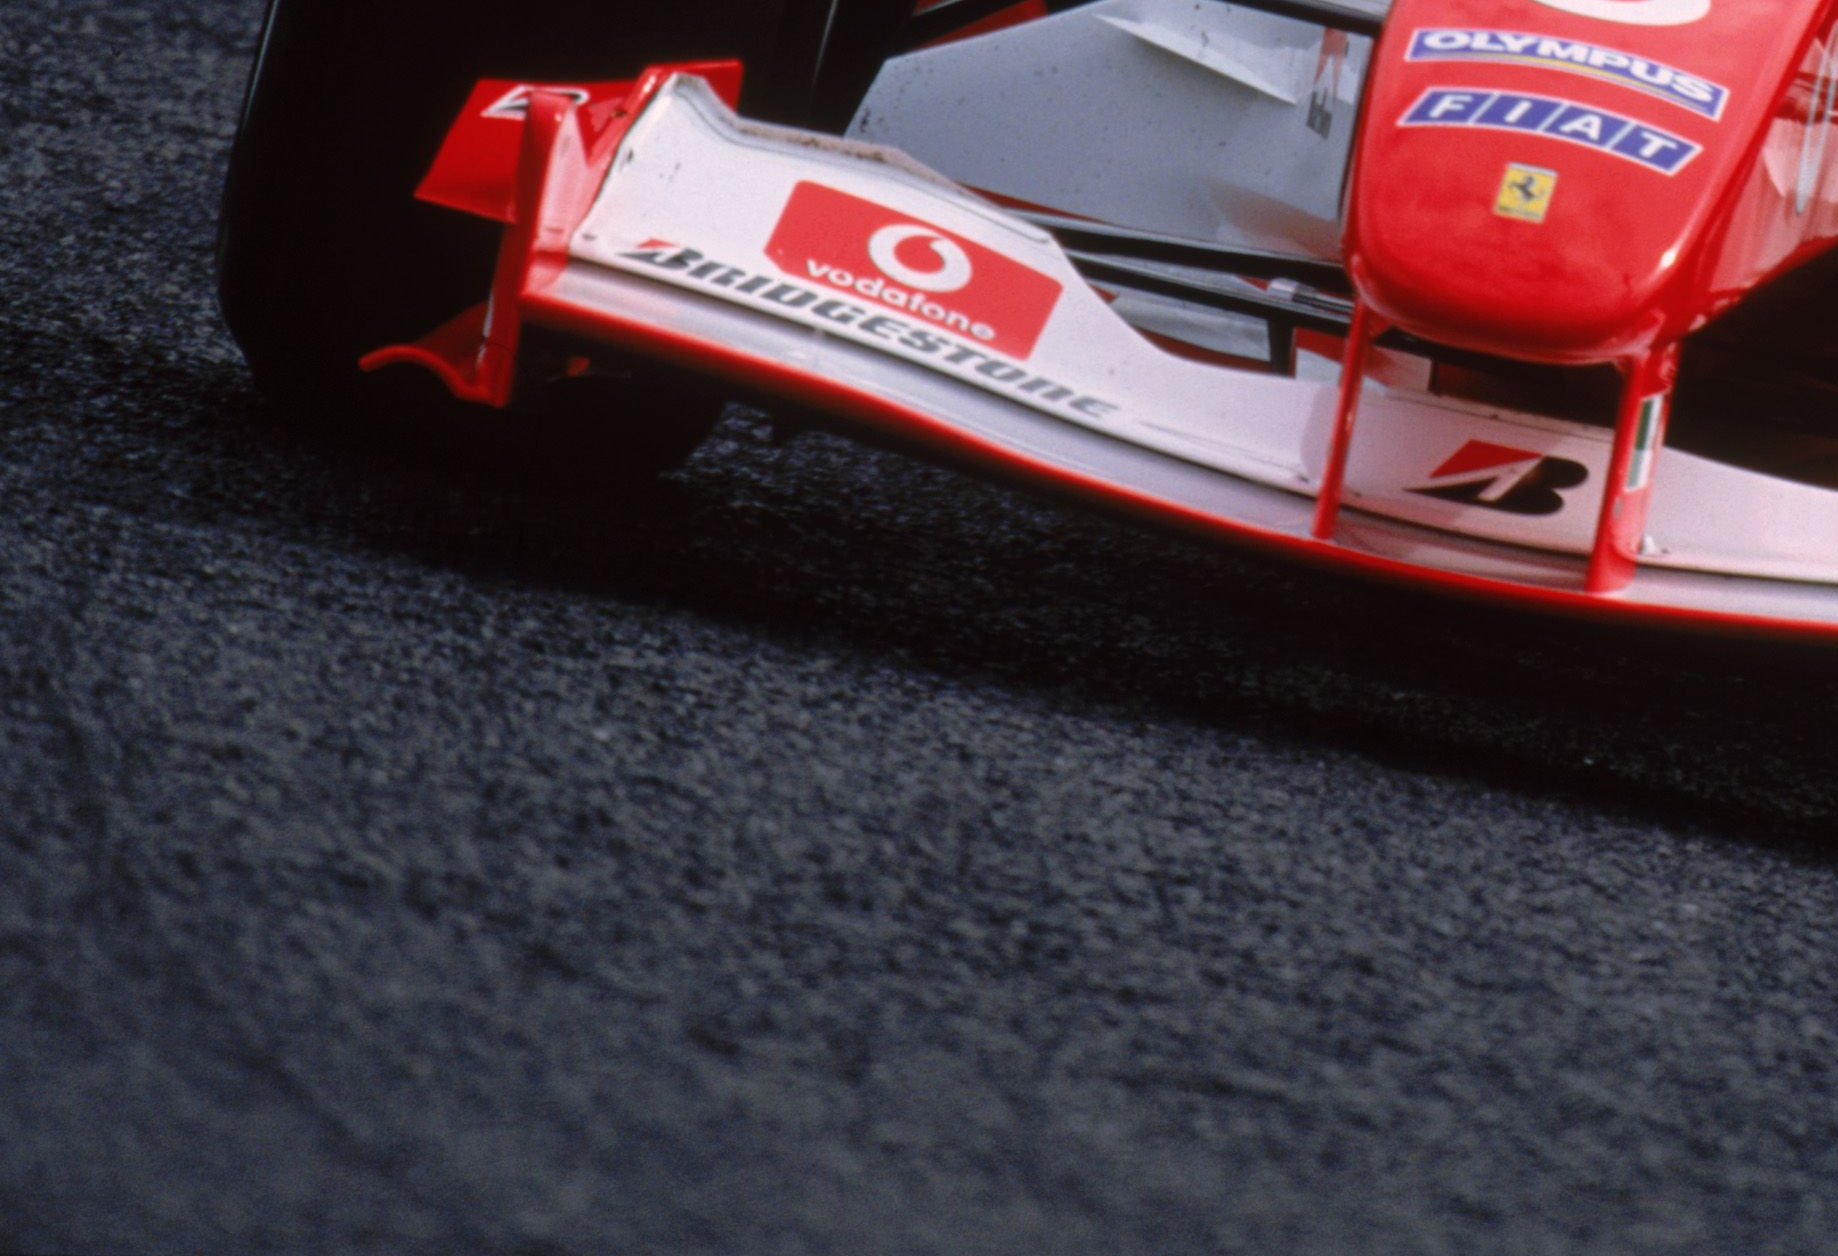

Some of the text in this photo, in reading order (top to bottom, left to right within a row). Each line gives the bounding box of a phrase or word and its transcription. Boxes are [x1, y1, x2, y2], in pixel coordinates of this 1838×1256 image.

[1423, 31, 1714, 102] OLYMPUS
[1428, 94, 1678, 158] FIAT
[617, 238, 1119, 418] BRIDGESTONE
[806, 258, 995, 341] vodafone
